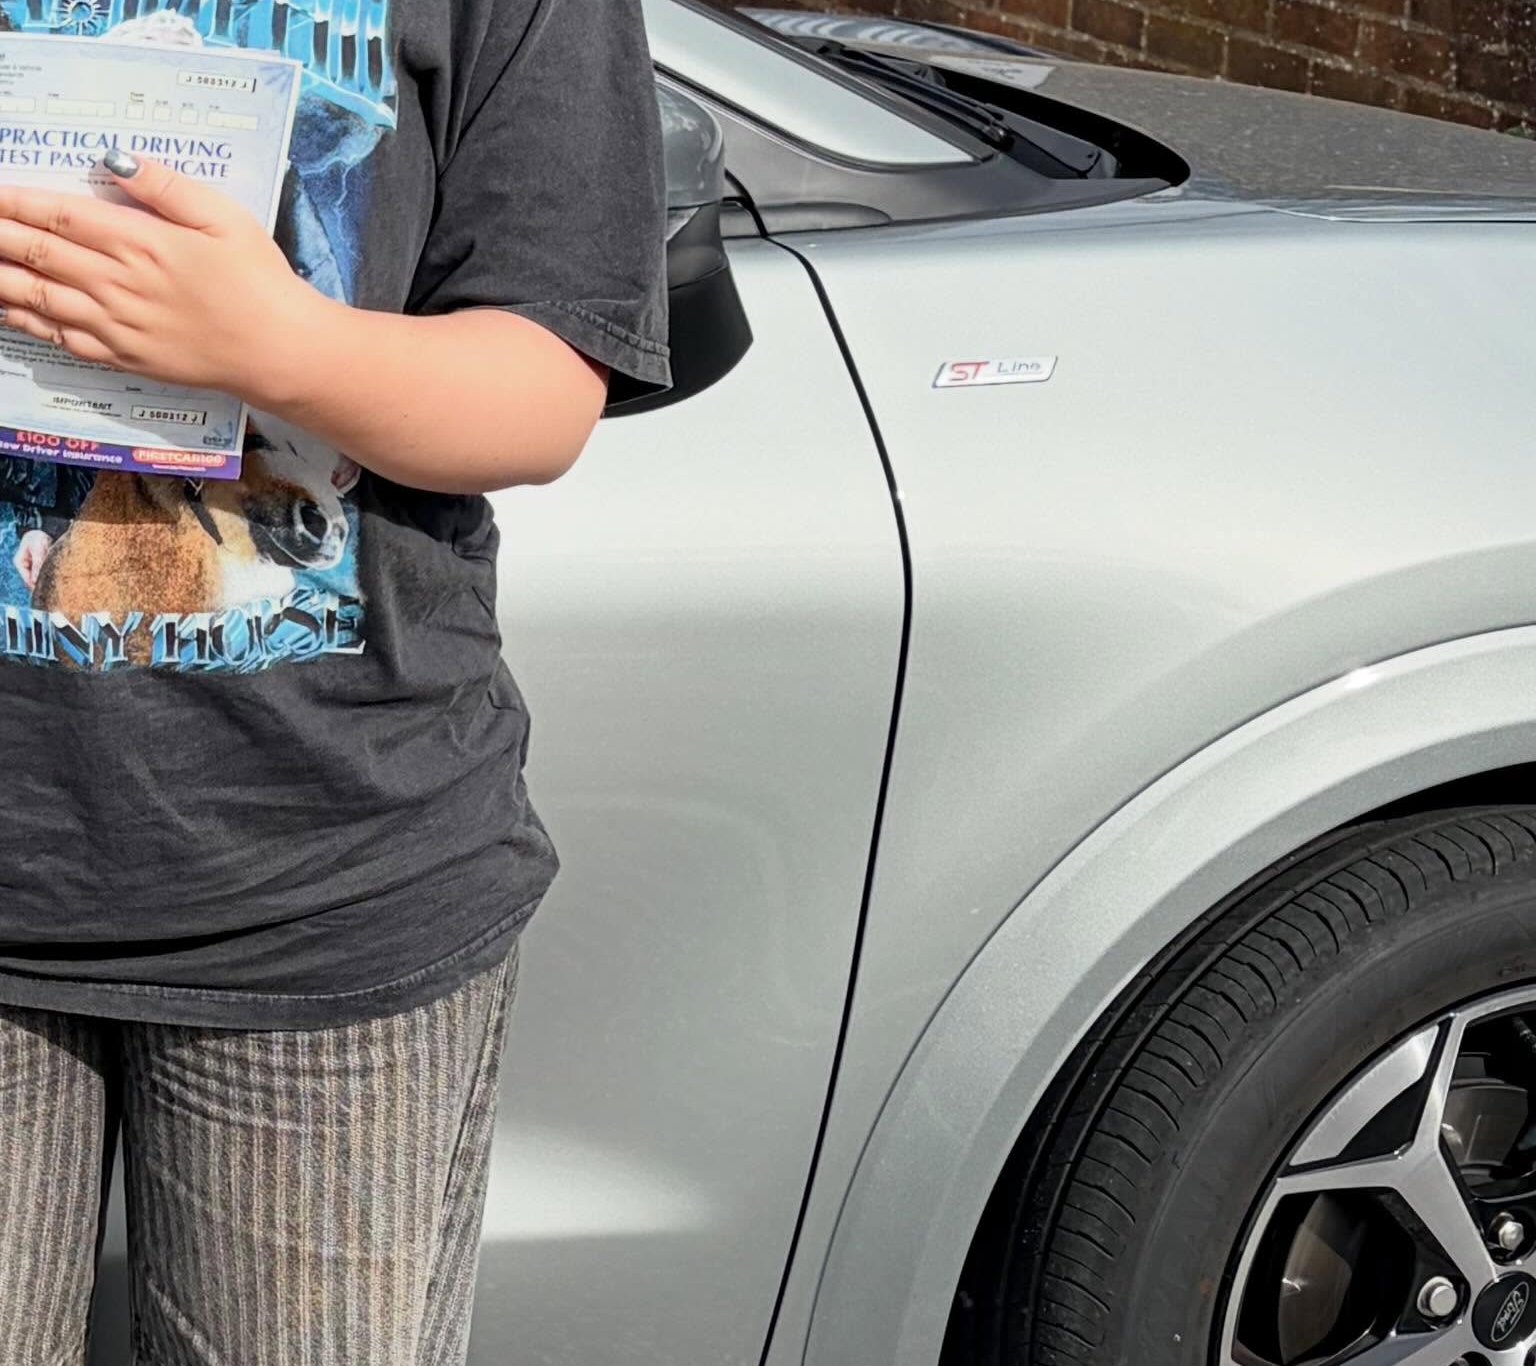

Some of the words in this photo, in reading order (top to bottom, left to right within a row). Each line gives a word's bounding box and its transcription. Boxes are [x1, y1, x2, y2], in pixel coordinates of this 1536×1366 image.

[131, 135, 233, 160] DRIVING
[50, 151, 97, 169] PASS
[950, 361, 990, 381] ST
[15, 430, 61, 447] £100
[64, 436, 100, 451] OFF
[23, 443, 59, 458] Driver
[62, 448, 123, 464] Insurance
[1497, 1290, 1525, 1333] Ford
